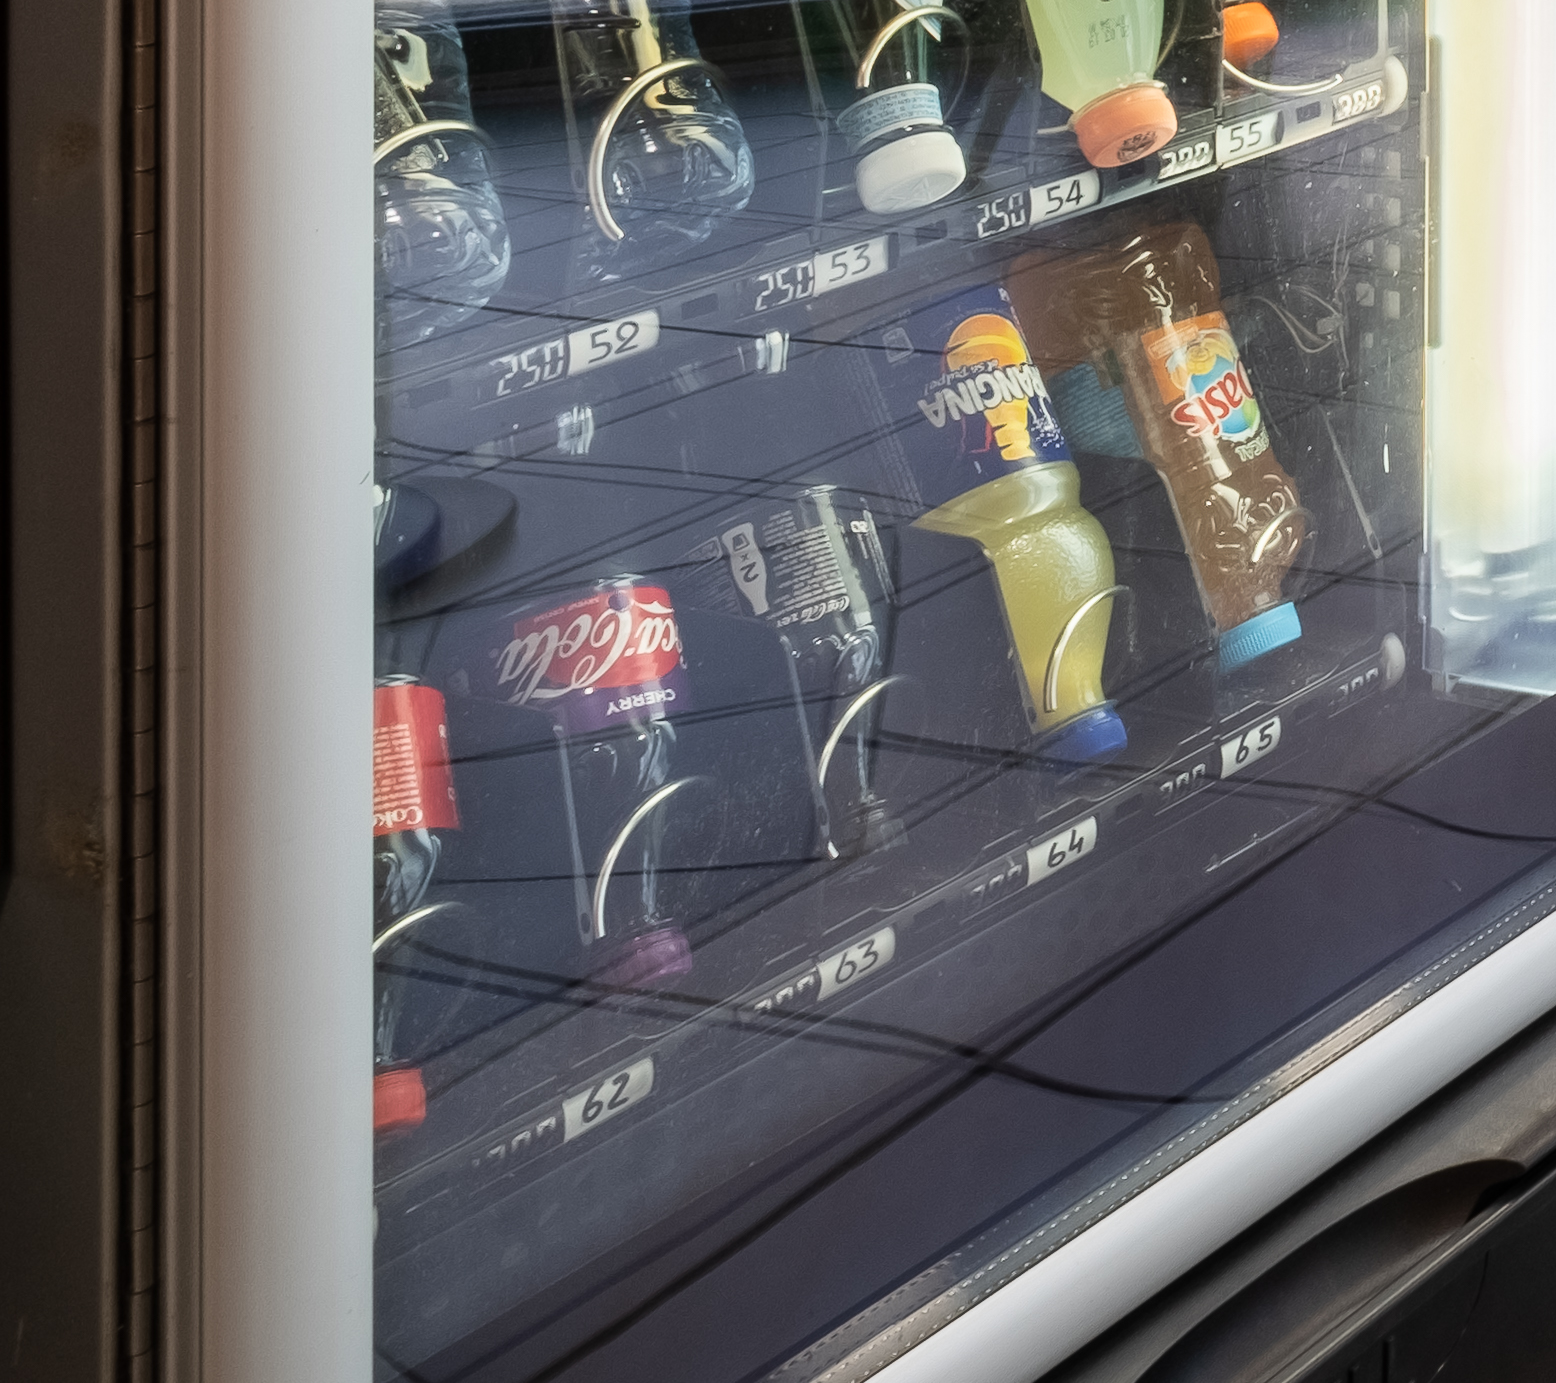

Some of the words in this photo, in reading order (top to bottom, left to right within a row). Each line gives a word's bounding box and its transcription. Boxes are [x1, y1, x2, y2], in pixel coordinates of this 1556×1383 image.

[492, 338, 566, 398] 250
[587, 321, 640, 364] 52
[754, 260, 814, 312] 250
[828, 243, 871, 283] 53
[975, 192, 1026, 240] 250
[1045, 180, 1084, 216] 54
[1229, 120, 1263, 154] 55
[916, 363, 1047, 430] RANGINA
[604, 688, 677, 718] CHERRY
[1234, 720, 1275, 765] 65
[1046, 829, 1086, 869] 64
[833, 940, 880, 985] 63
[579, 1072, 631, 1124] 62
